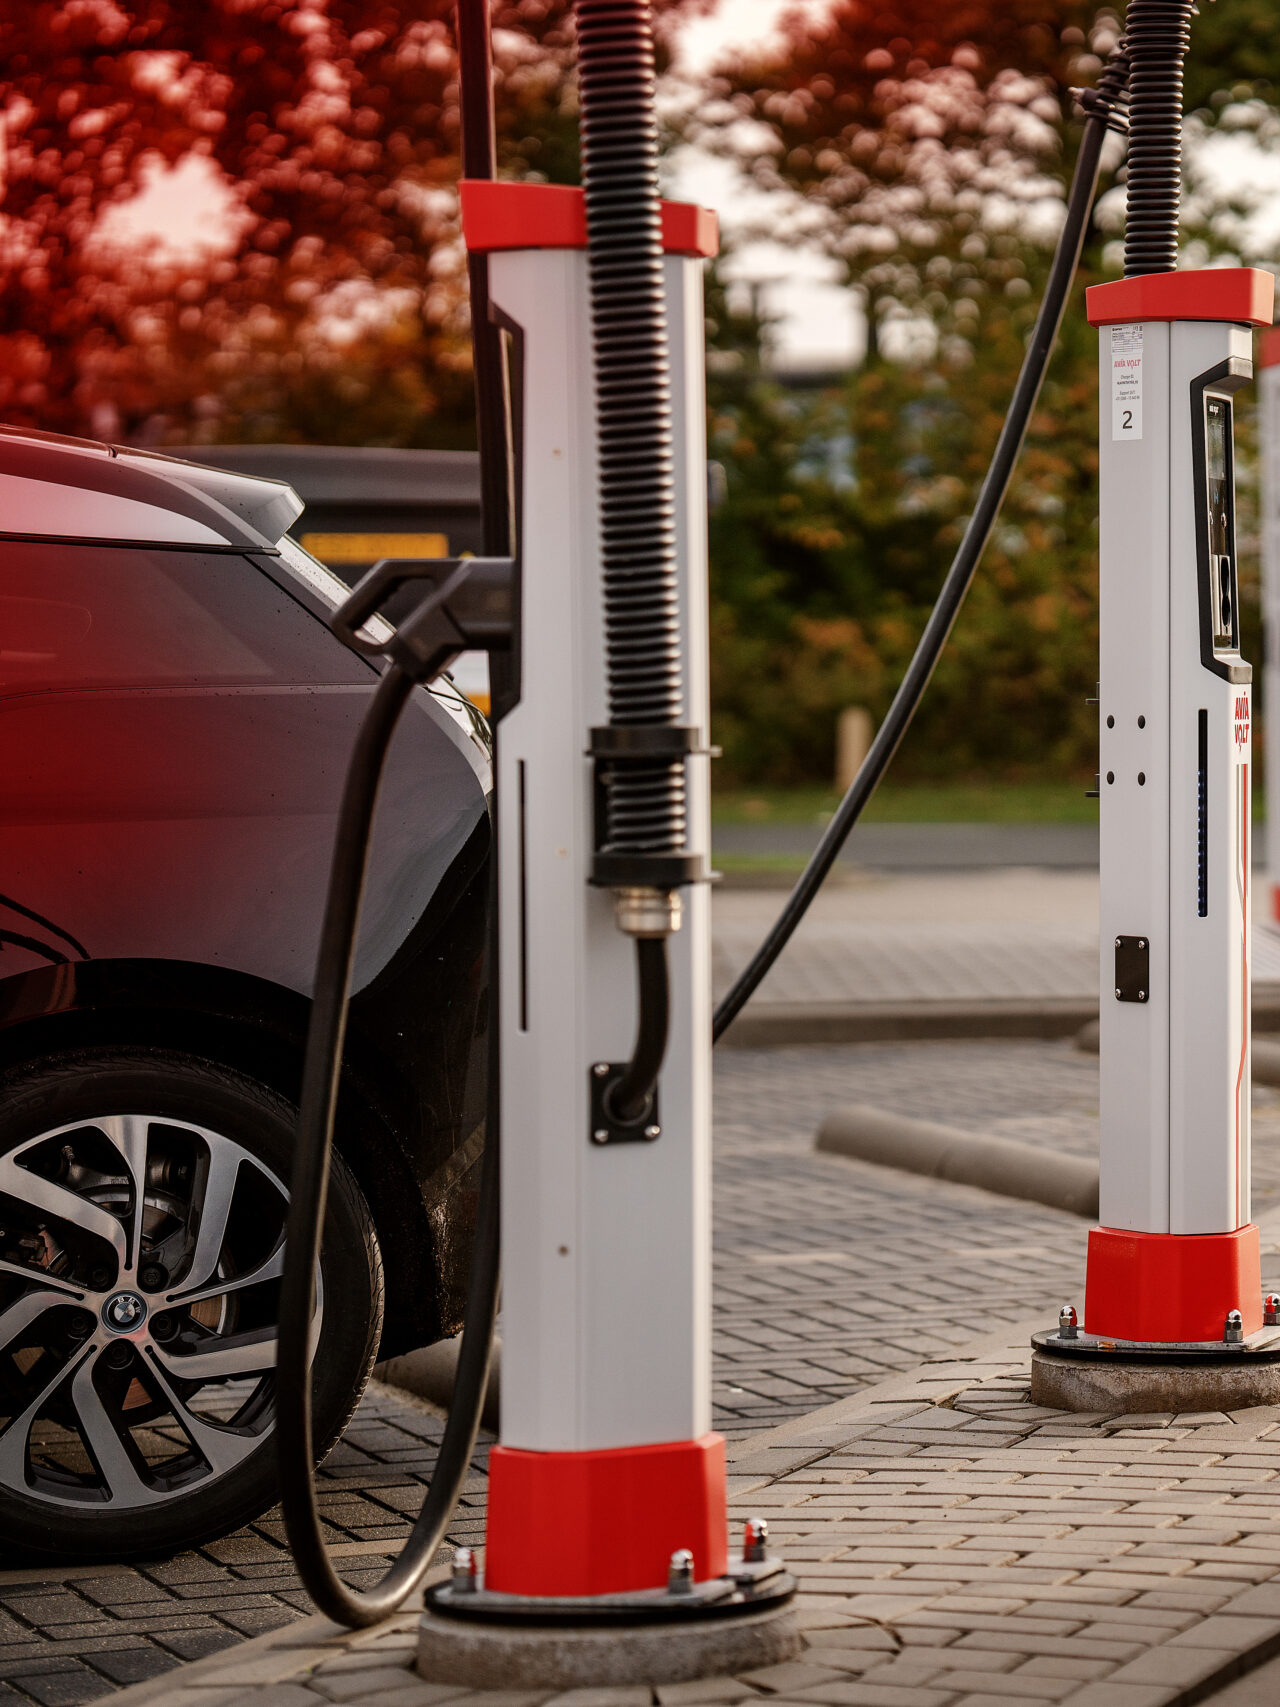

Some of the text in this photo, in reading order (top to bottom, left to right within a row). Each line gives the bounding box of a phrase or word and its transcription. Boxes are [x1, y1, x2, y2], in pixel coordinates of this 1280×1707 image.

[1114, 359, 1141, 370] AVIA VOLT
[1122, 410, 1133, 429] 2
[1235, 692, 1249, 720] AVIA
[1235, 724, 1249, 752] VOLT
[117, 1296, 141, 1313] BMW
